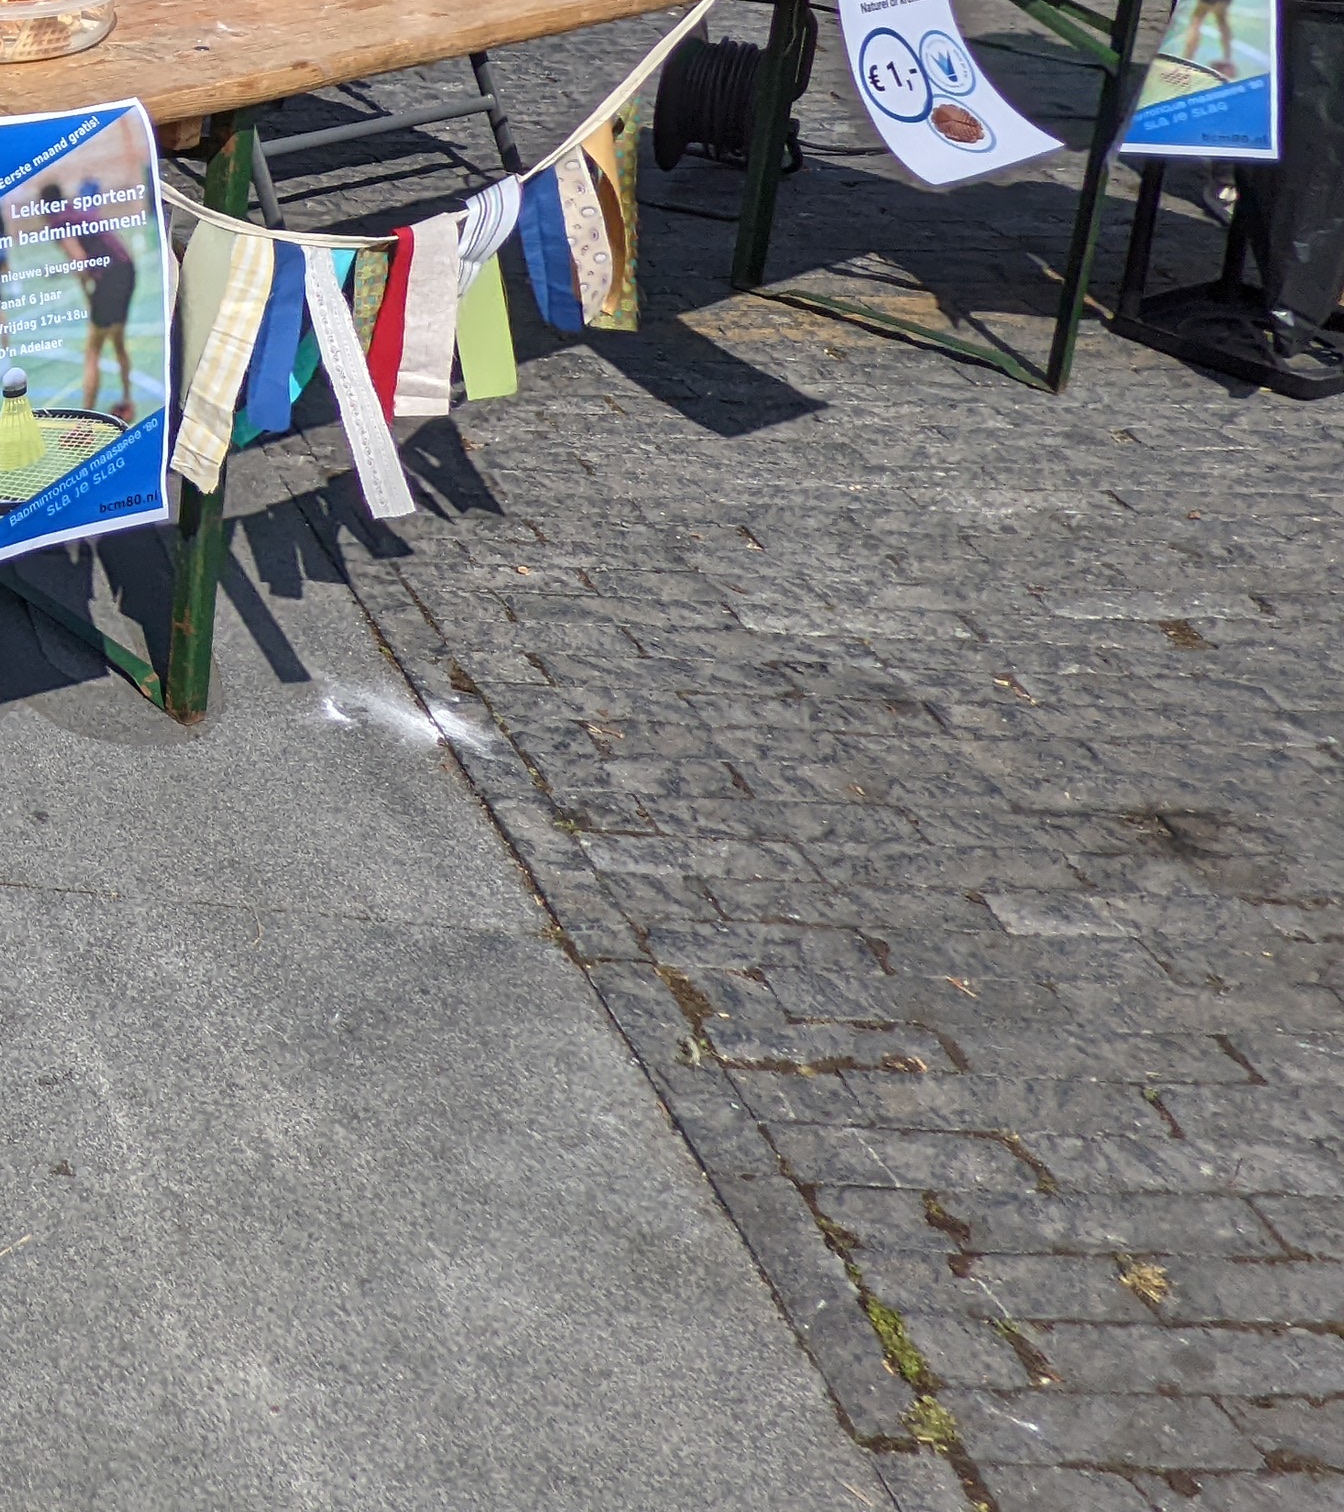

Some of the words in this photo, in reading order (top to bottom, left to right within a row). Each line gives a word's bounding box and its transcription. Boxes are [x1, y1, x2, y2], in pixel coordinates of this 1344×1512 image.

[33, 137, 68, 167] maand
[68, 115, 100, 145] gratis!
[11, 199, 68, 219] Lekker
[73, 185, 146, 212] sporten?
[19, 210, 148, 246] badmintonnen!
[1, 267, 42, 284] nieuwe
[44, 256, 110, 278] jeugdgroep
[29, 294, 37, 304] 6
[39, 290, 62, 303] jaar
[40, 309, 88, 326] 17u-18u
[20, 339, 63, 355] Adelaer
[99, 490, 159, 513] bcm80.nl
